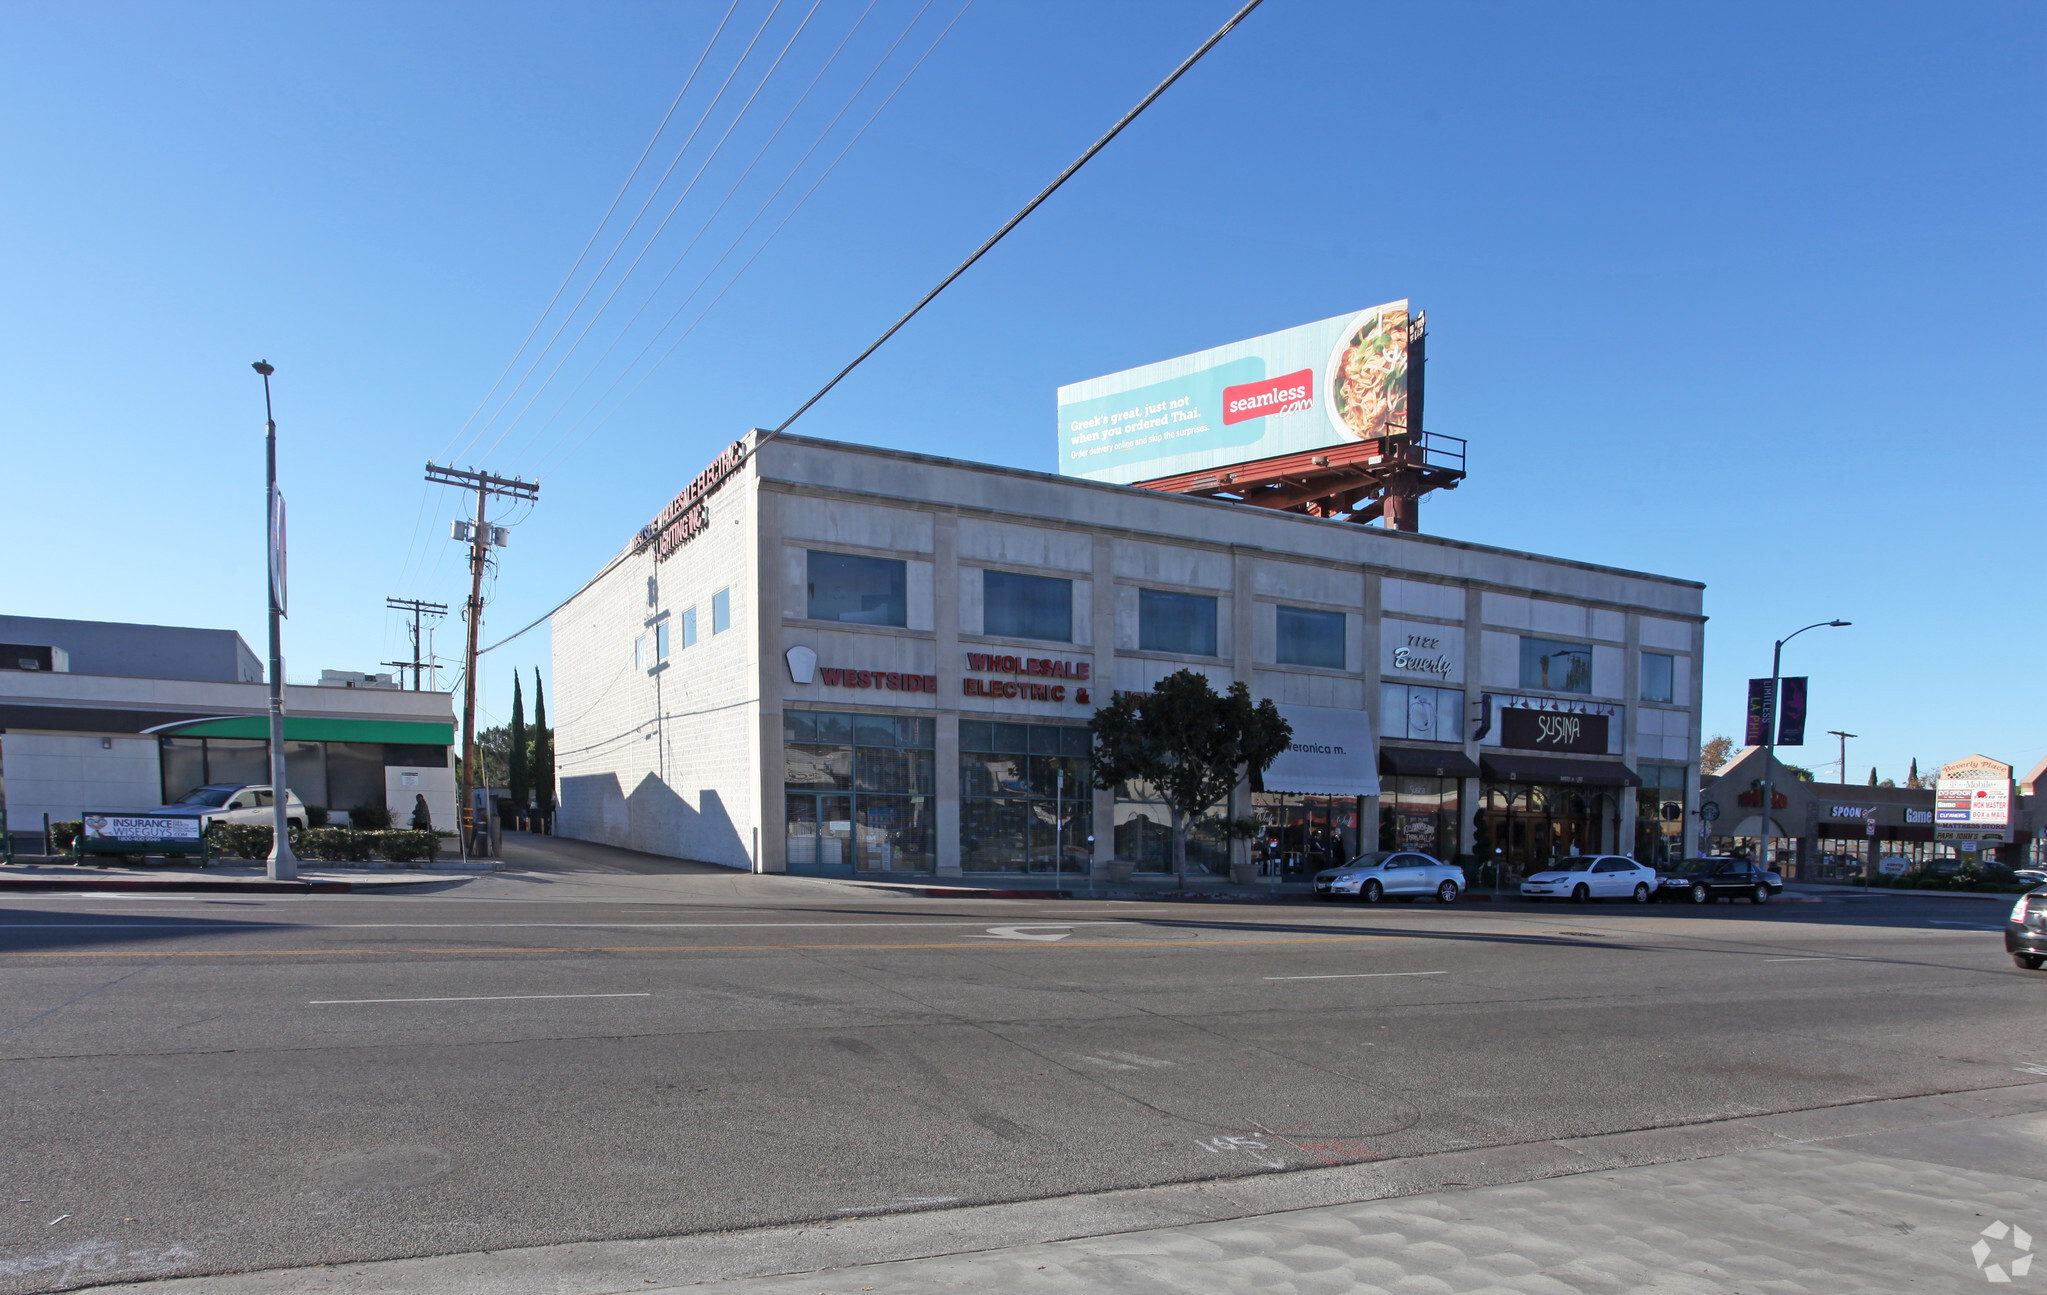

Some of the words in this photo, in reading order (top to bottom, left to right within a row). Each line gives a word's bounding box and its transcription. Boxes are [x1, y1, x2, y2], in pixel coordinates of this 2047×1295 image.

[1229, 385, 1306, 413] seamless
[1070, 414, 1109, 432] Greek's
[1111, 407, 1142, 425] great,
[1145, 401, 1167, 418] just
[1169, 395, 1190, 409] not
[1071, 432, 1100, 445] when
[1102, 426, 1122, 440] you
[1124, 415, 1169, 433] ordered
[1171, 407, 1202, 423] Thai.
[1071, 449, 1089, 459] Order
[1089, 443, 1113, 456] delivery
[1115, 439, 1134, 450] online
[1135, 435, 1148, 446] and
[1149, 432, 1163, 444] skip
[1164, 430, 1175, 440] the
[1176, 423, 1211, 437] surprises.
[967, 652, 1090, 680] WHOLESALE
[1394, 647, 1452, 680] Beverly
[820, 667, 938, 694] WESTSIDE
[964, 678, 1066, 703] ELECTRIC
[1076, 687, 1091, 705] &
[1750, 697, 1761, 712] LA
[1762, 680, 1772, 724] LIMITLESS
[1536, 715, 1580, 744] SUSINA
[1748, 714, 1760, 743] PHIL
[1334, 746, 1347, 755] m.
[1942, 761, 1979, 773] Beverly
[1981, 761, 2007, 773] Place
[113, 818, 172, 828] INSURANCE
[1832, 806, 1862, 818] SPOON
[1905, 807, 1933, 824] Game
[113, 827, 172, 837] WISEGUYS
